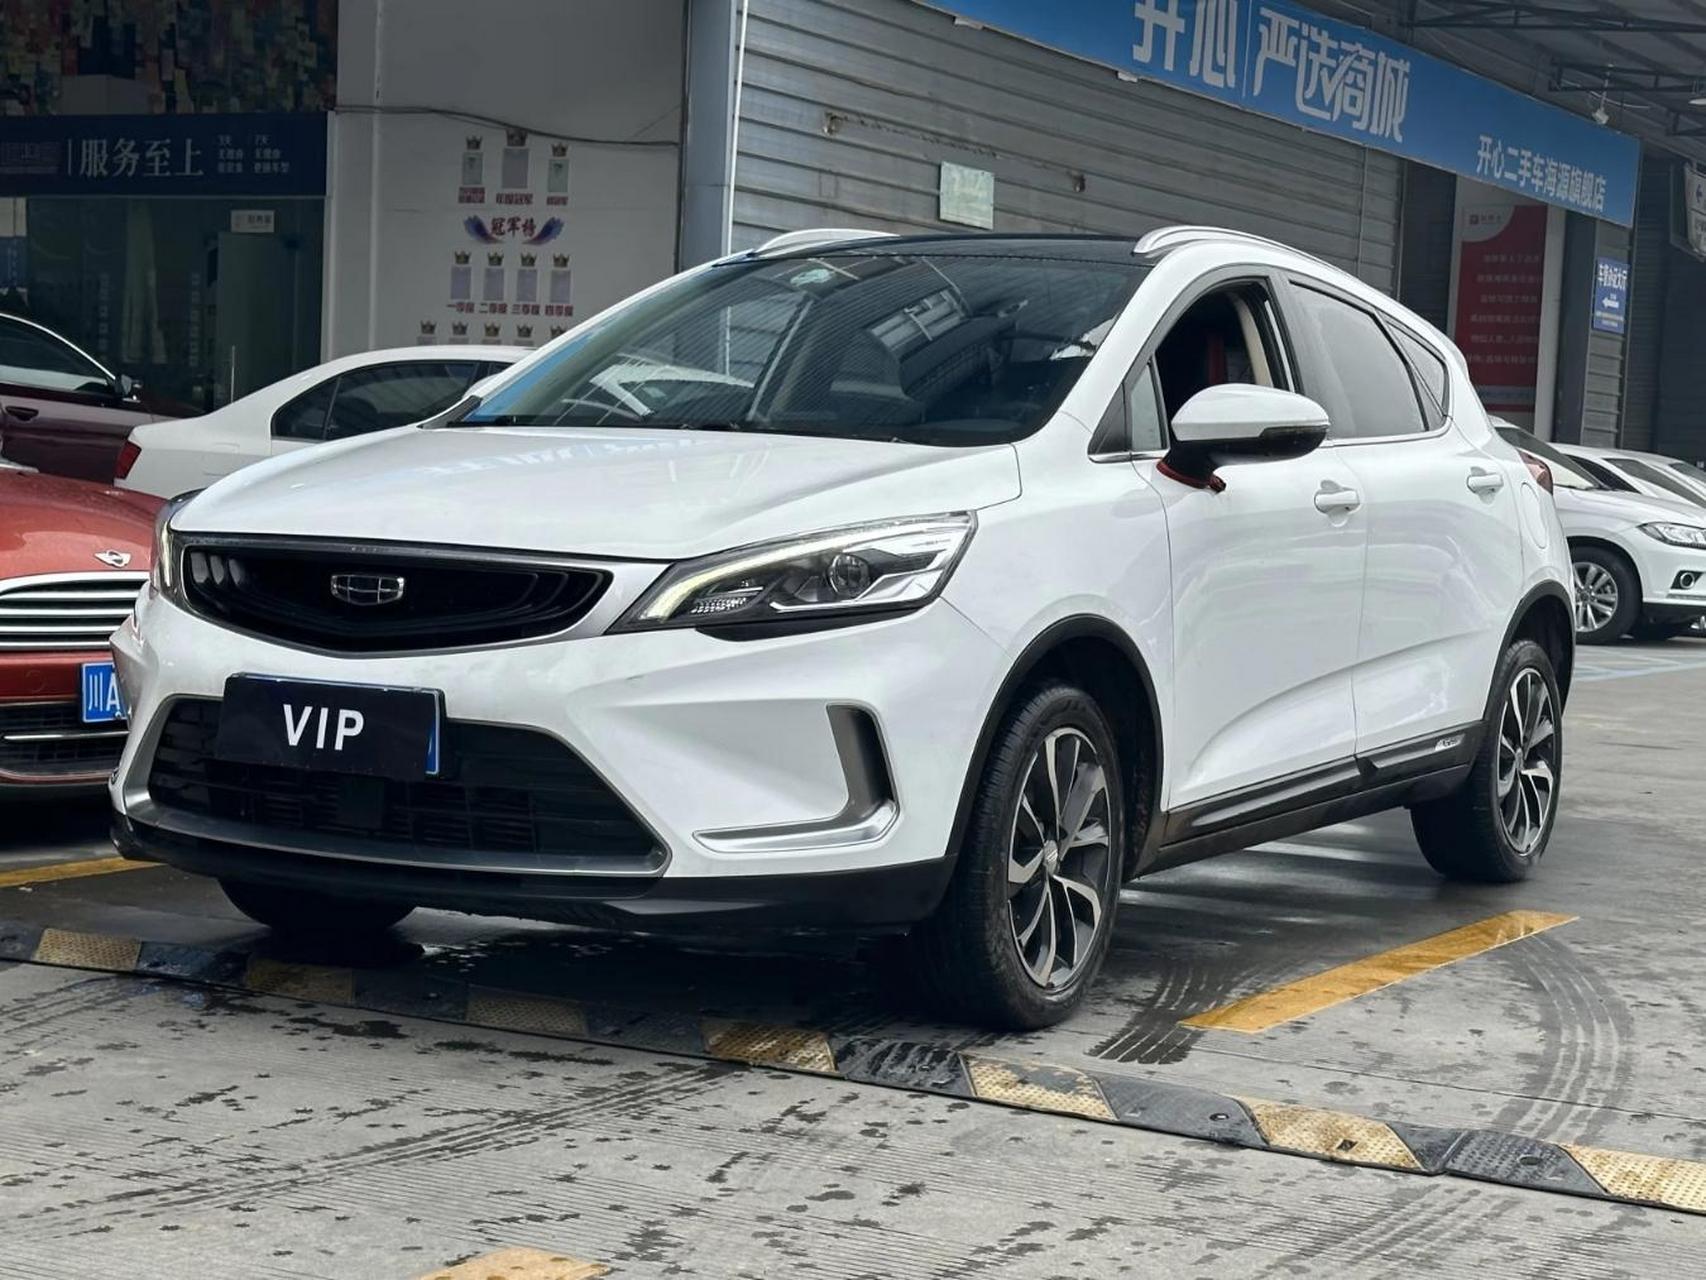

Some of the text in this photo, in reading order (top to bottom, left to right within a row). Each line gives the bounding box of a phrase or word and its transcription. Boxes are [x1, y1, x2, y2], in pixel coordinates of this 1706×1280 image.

[1133, 0, 1411, 144] 开心 严选商城
[79, 138, 204, 178] 服务至上
[88, 671, 121, 712] 川A
[282, 703, 365, 752] VIP
